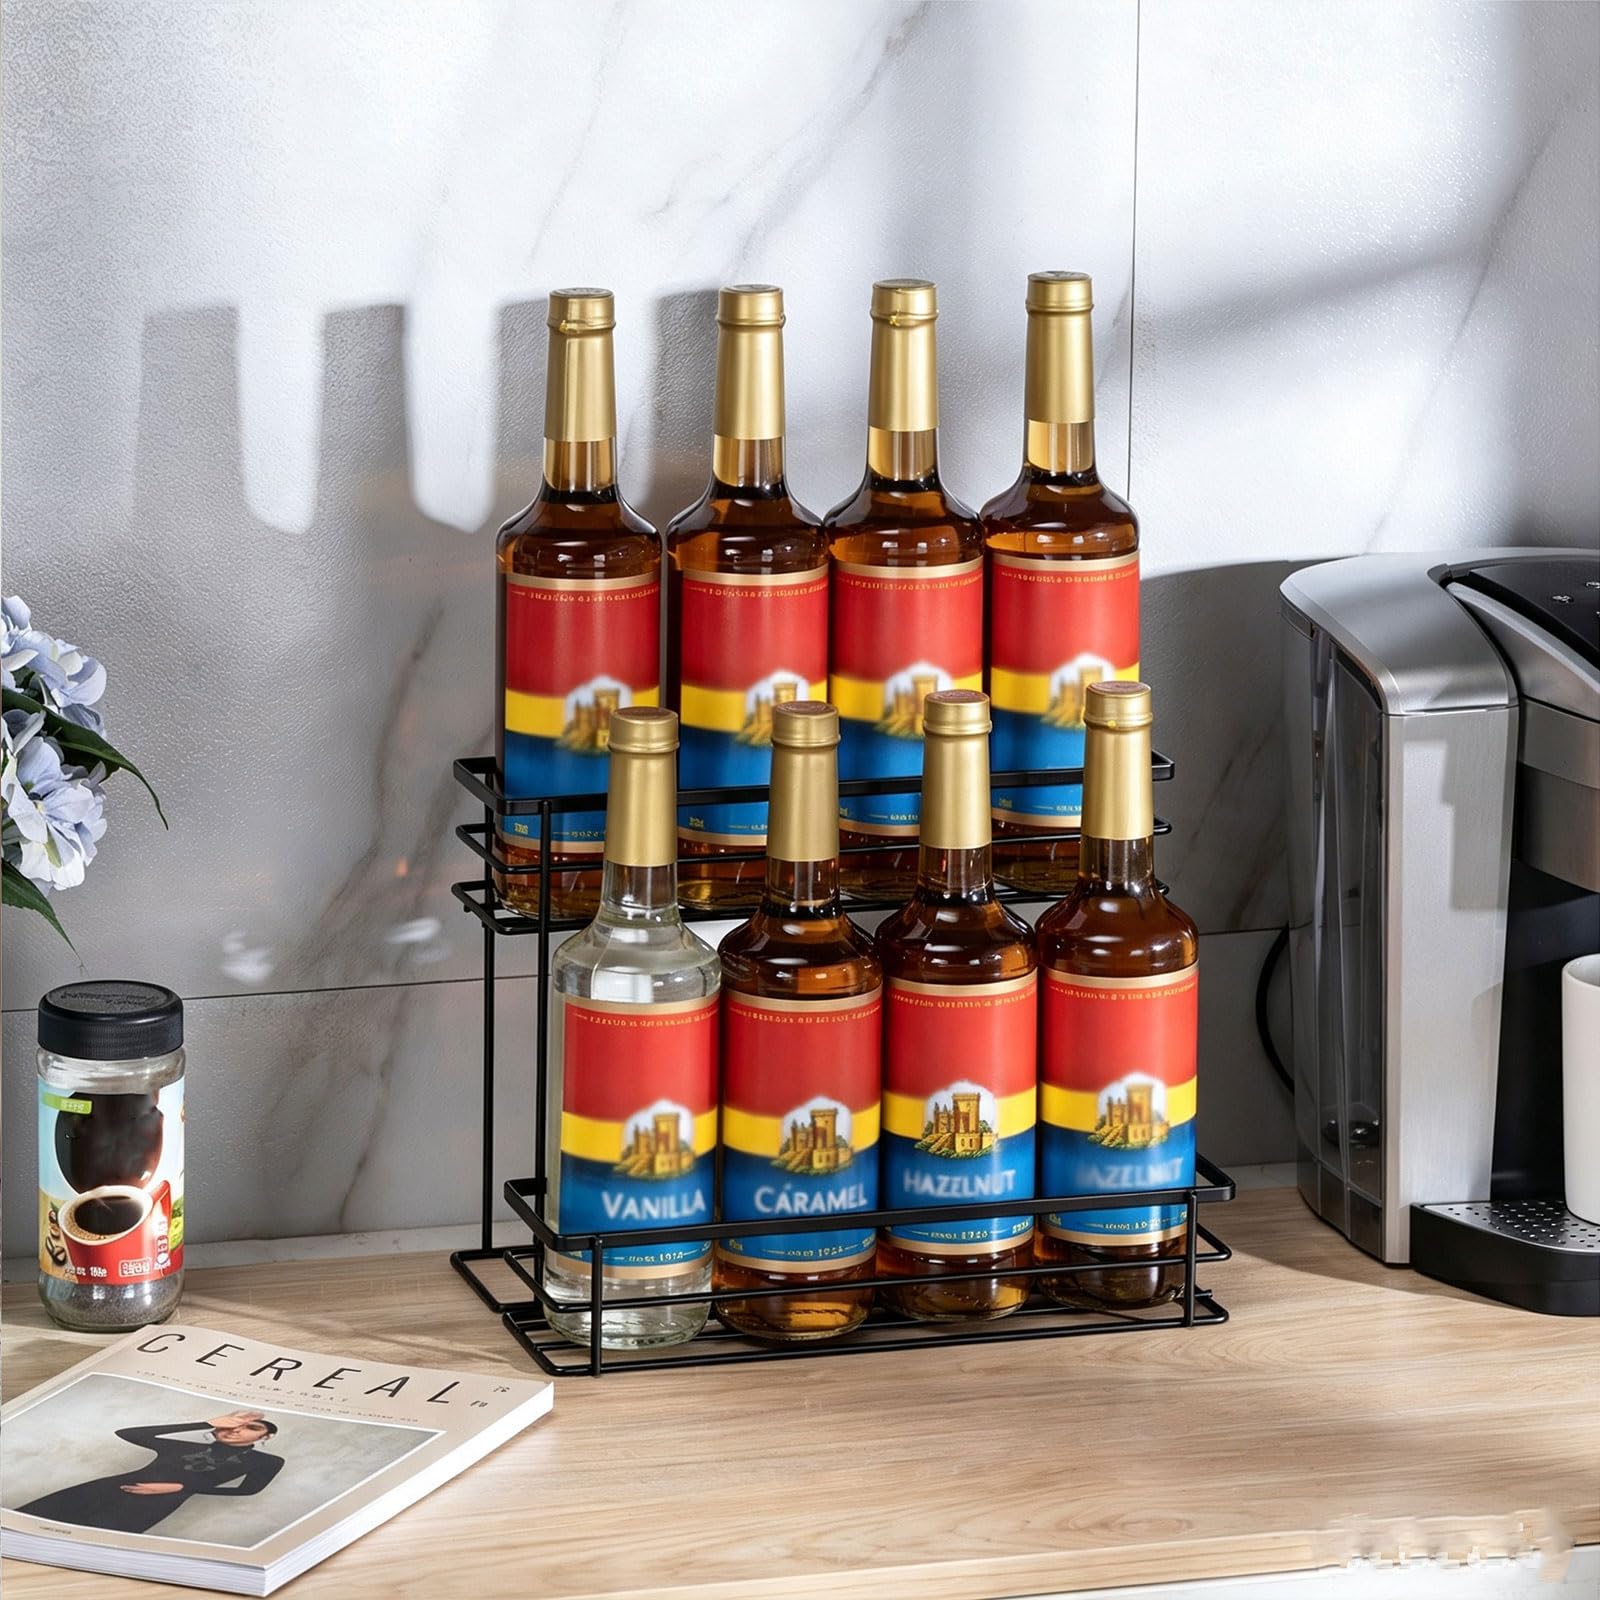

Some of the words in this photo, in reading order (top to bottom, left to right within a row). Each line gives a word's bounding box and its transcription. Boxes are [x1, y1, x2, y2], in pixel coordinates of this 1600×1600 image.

[903, 1168, 1016, 1197] HAZELNUT
[602, 1188, 706, 1219] VANILLA
[136, 1333, 460, 1404] CEREAL
